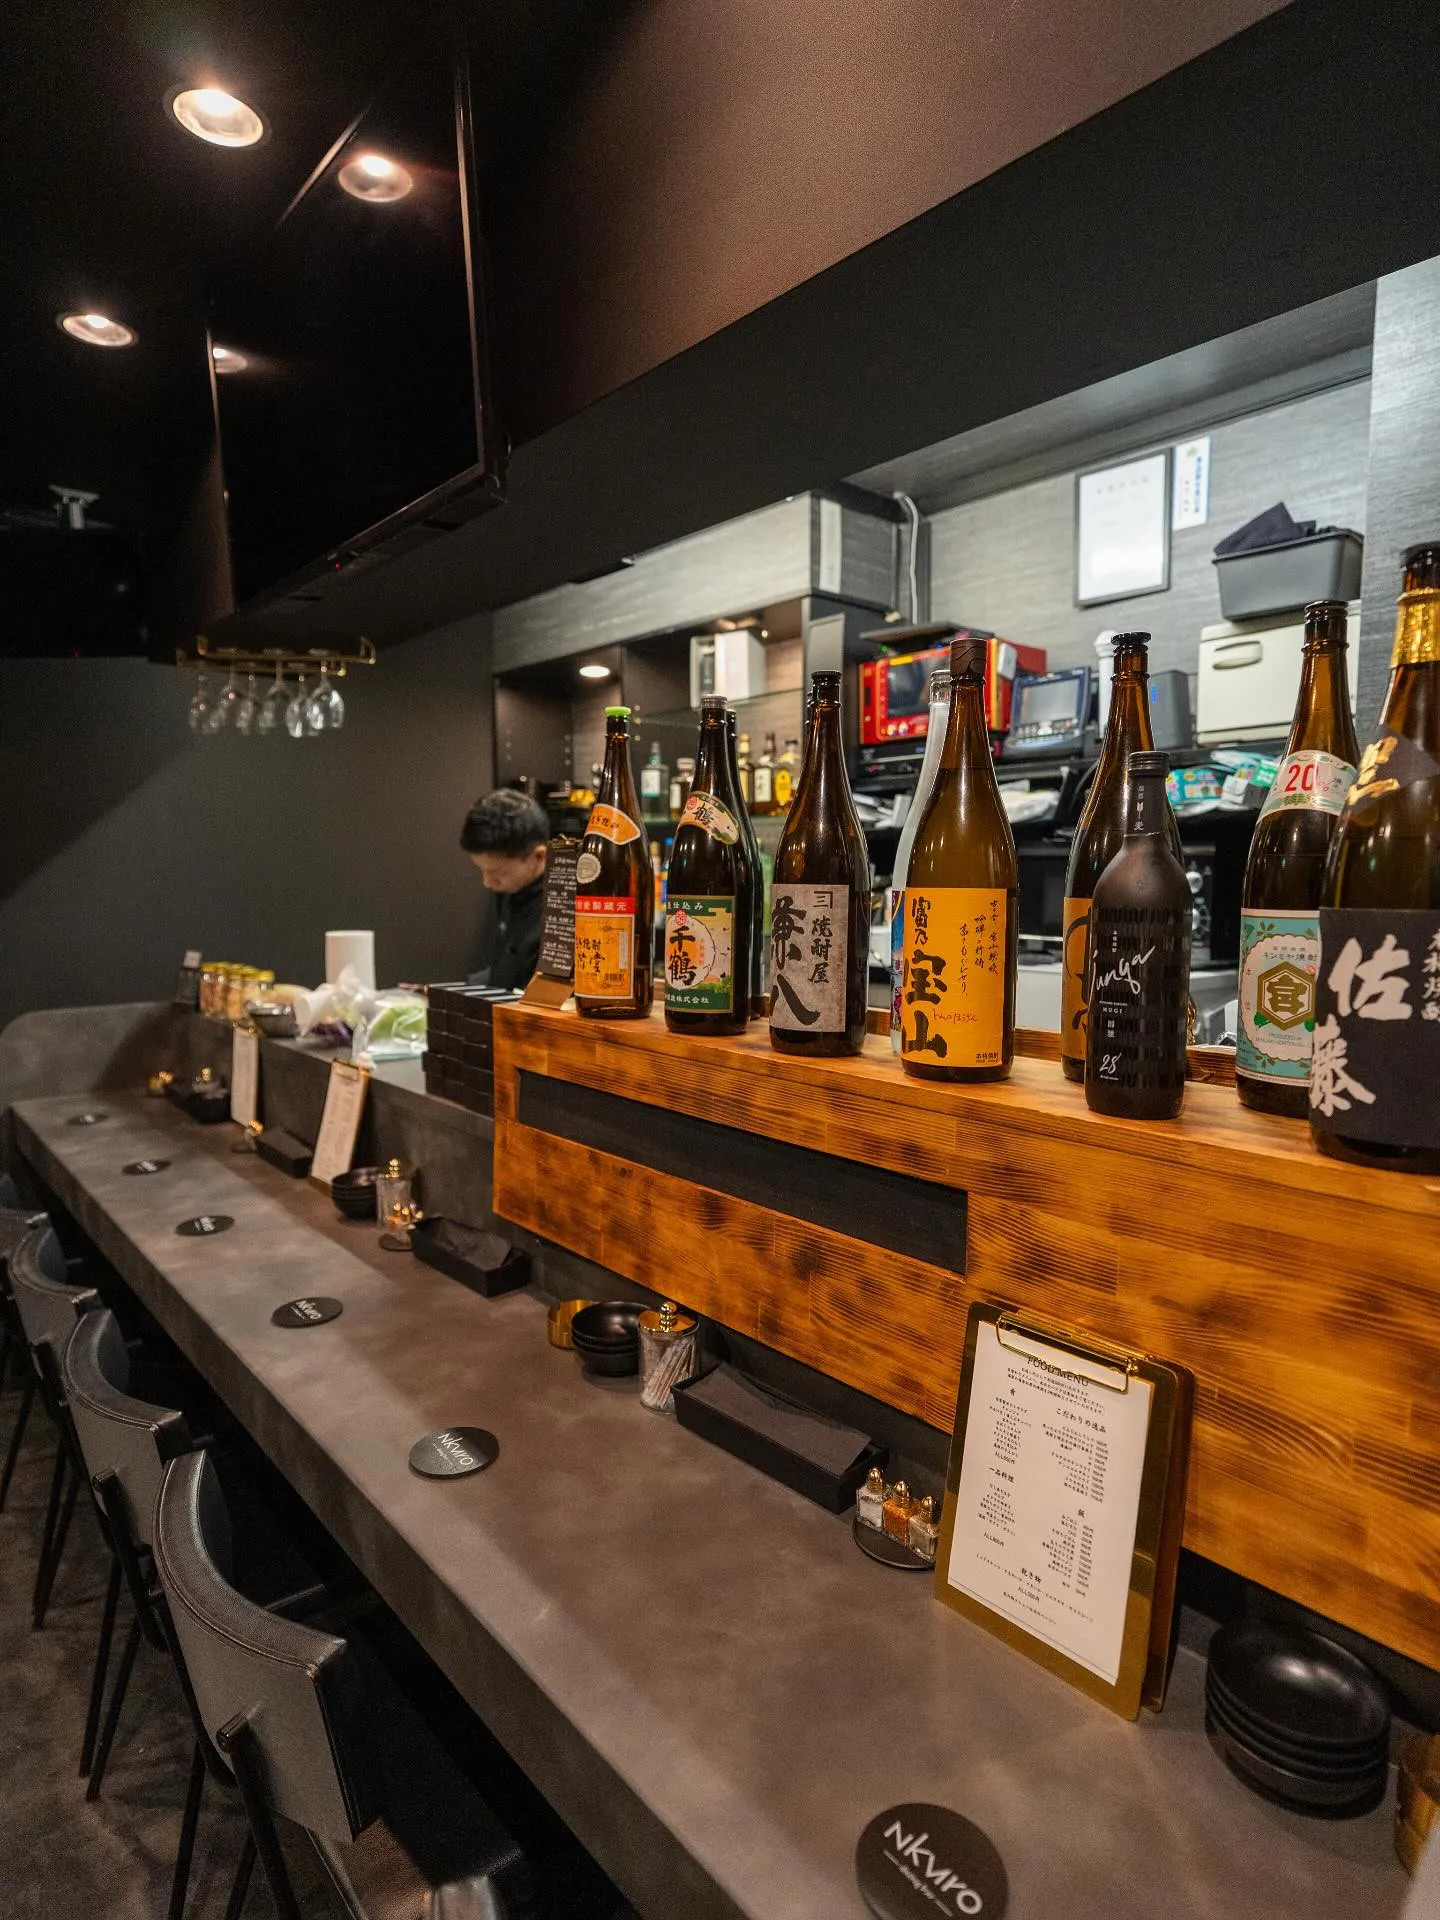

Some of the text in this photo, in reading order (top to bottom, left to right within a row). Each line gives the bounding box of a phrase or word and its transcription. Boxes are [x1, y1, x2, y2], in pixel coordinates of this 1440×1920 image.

[668, 925, 697, 986] 千鶴
[808, 914, 833, 984] 焼酎屋
[1100, 1052, 1121, 1075] 28
